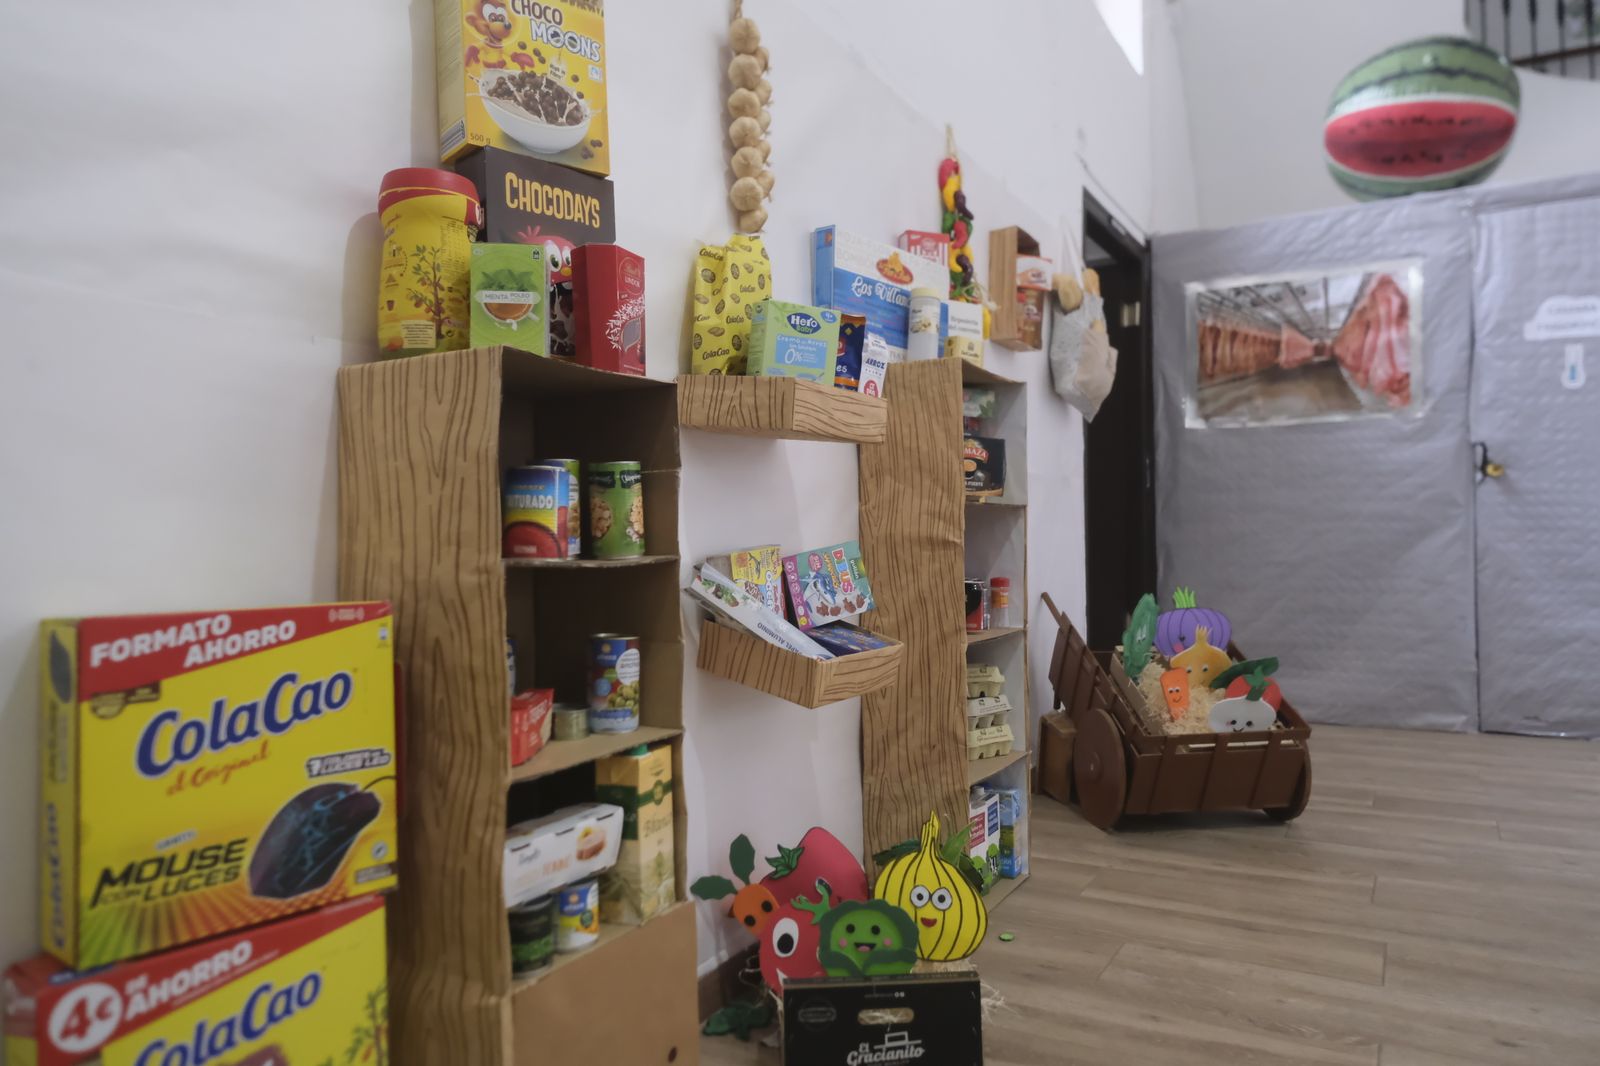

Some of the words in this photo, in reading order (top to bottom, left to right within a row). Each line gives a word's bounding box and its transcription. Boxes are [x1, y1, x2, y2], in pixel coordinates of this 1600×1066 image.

[510, 0, 563, 26] CHOCO
[530, 19, 601, 62] MOONS
[505, 171, 600, 229] CHOCODAYS
[484, 293, 509, 301] MENTA
[852, 275, 872, 298] Los
[790, 314, 818, 329] Hero
[702, 347, 730, 360] ColaCao
[865, 357, 885, 370] ARROZ
[964, 447, 986, 459] MAZA
[90, 614, 231, 668] FORMATO
[183, 620, 296, 668] AHORRO
[757, 622, 785, 645] ALUMINIO
[136, 671, 353, 777] ColaCao
[88, 837, 249, 909] MOUSE
[144, 866, 241, 901] LUCES
[125, 940, 253, 1022] AHORRO
[847, 1045, 925, 1066] Gracianito
[859, 1042, 870, 1053] El
